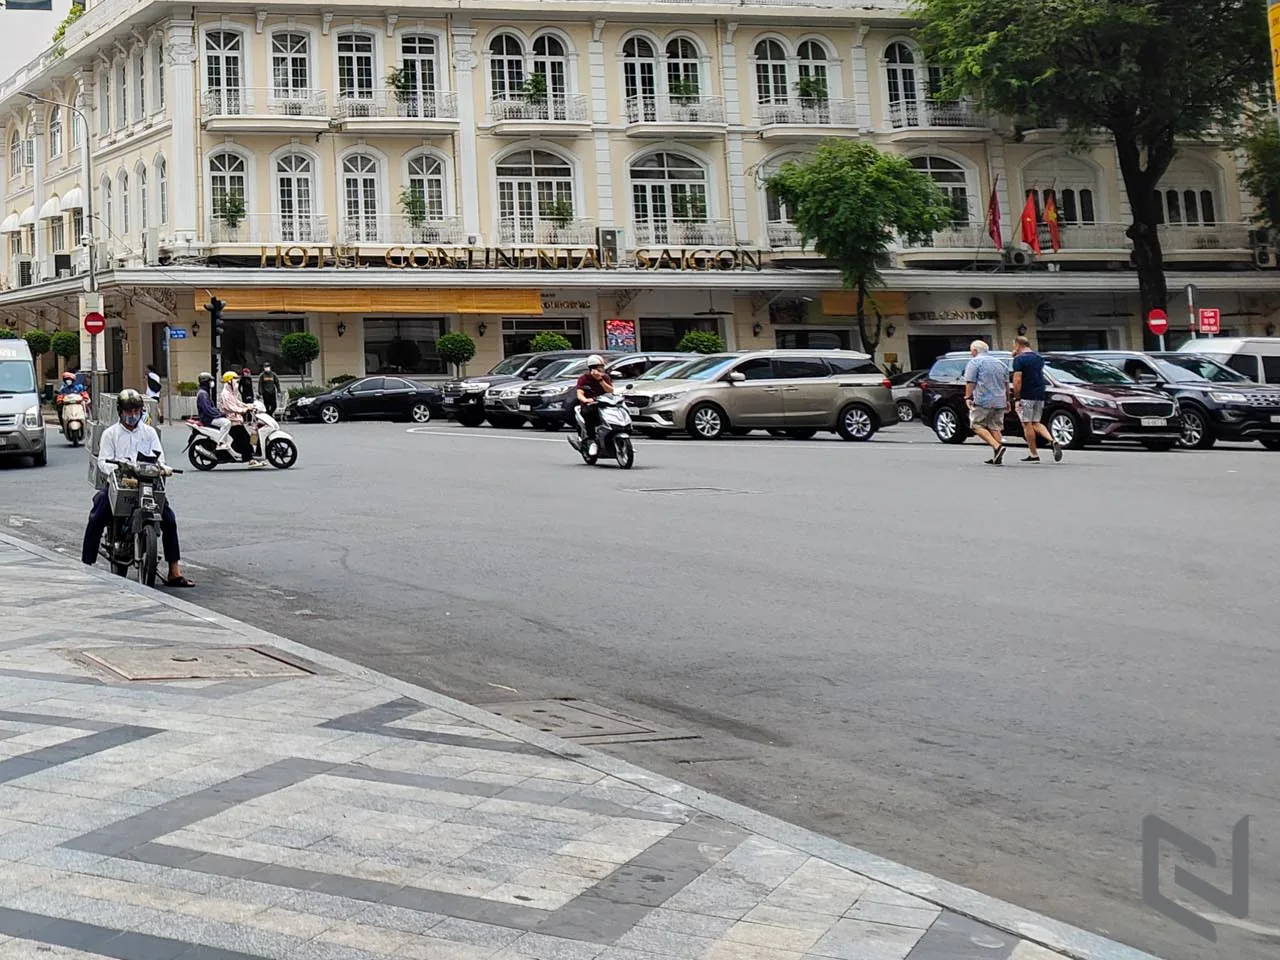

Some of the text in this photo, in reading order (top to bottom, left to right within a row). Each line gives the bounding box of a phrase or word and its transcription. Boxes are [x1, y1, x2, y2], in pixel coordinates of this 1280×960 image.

[260, 245, 763, 272] HOTEL CONTINENTAL SAIGON
